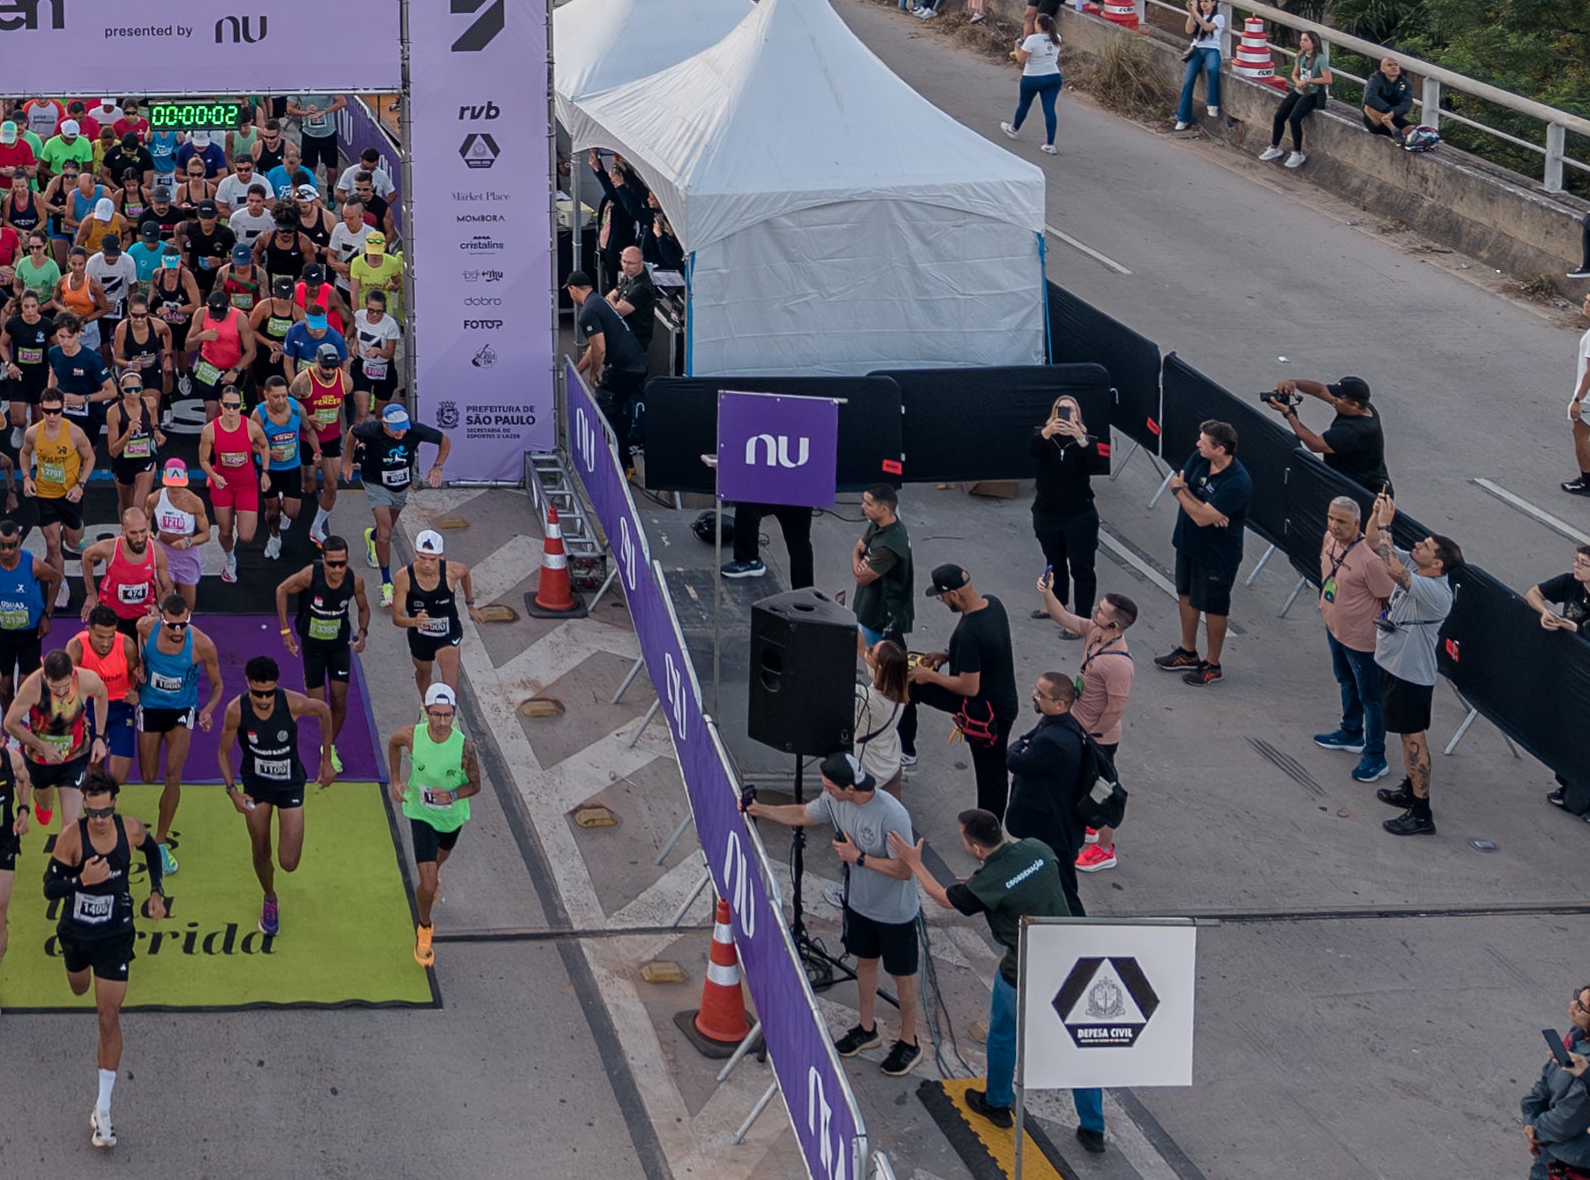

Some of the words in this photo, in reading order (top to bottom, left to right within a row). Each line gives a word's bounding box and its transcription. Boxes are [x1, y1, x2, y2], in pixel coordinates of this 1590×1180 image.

[104, 25, 173, 38] presented
[176, 25, 193, 38] by
[214, 15, 268, 44] nu
[151, 104, 239, 127] 00:00:02
[458, 101, 500, 120] rvb
[466, 405, 521, 413] PREFEITURA
[522, 405, 535, 413] DE
[466, 413, 492, 425] SÃO
[495, 415, 536, 426] PAULO
[576, 407, 596, 473] nu
[745, 432, 810, 469] nu
[665, 652, 688, 741] nu
[723, 830, 756, 939] nu
[1077, 1028, 1110, 1039] DEFESA
[1110, 1027, 1133, 1038] CIVIL
